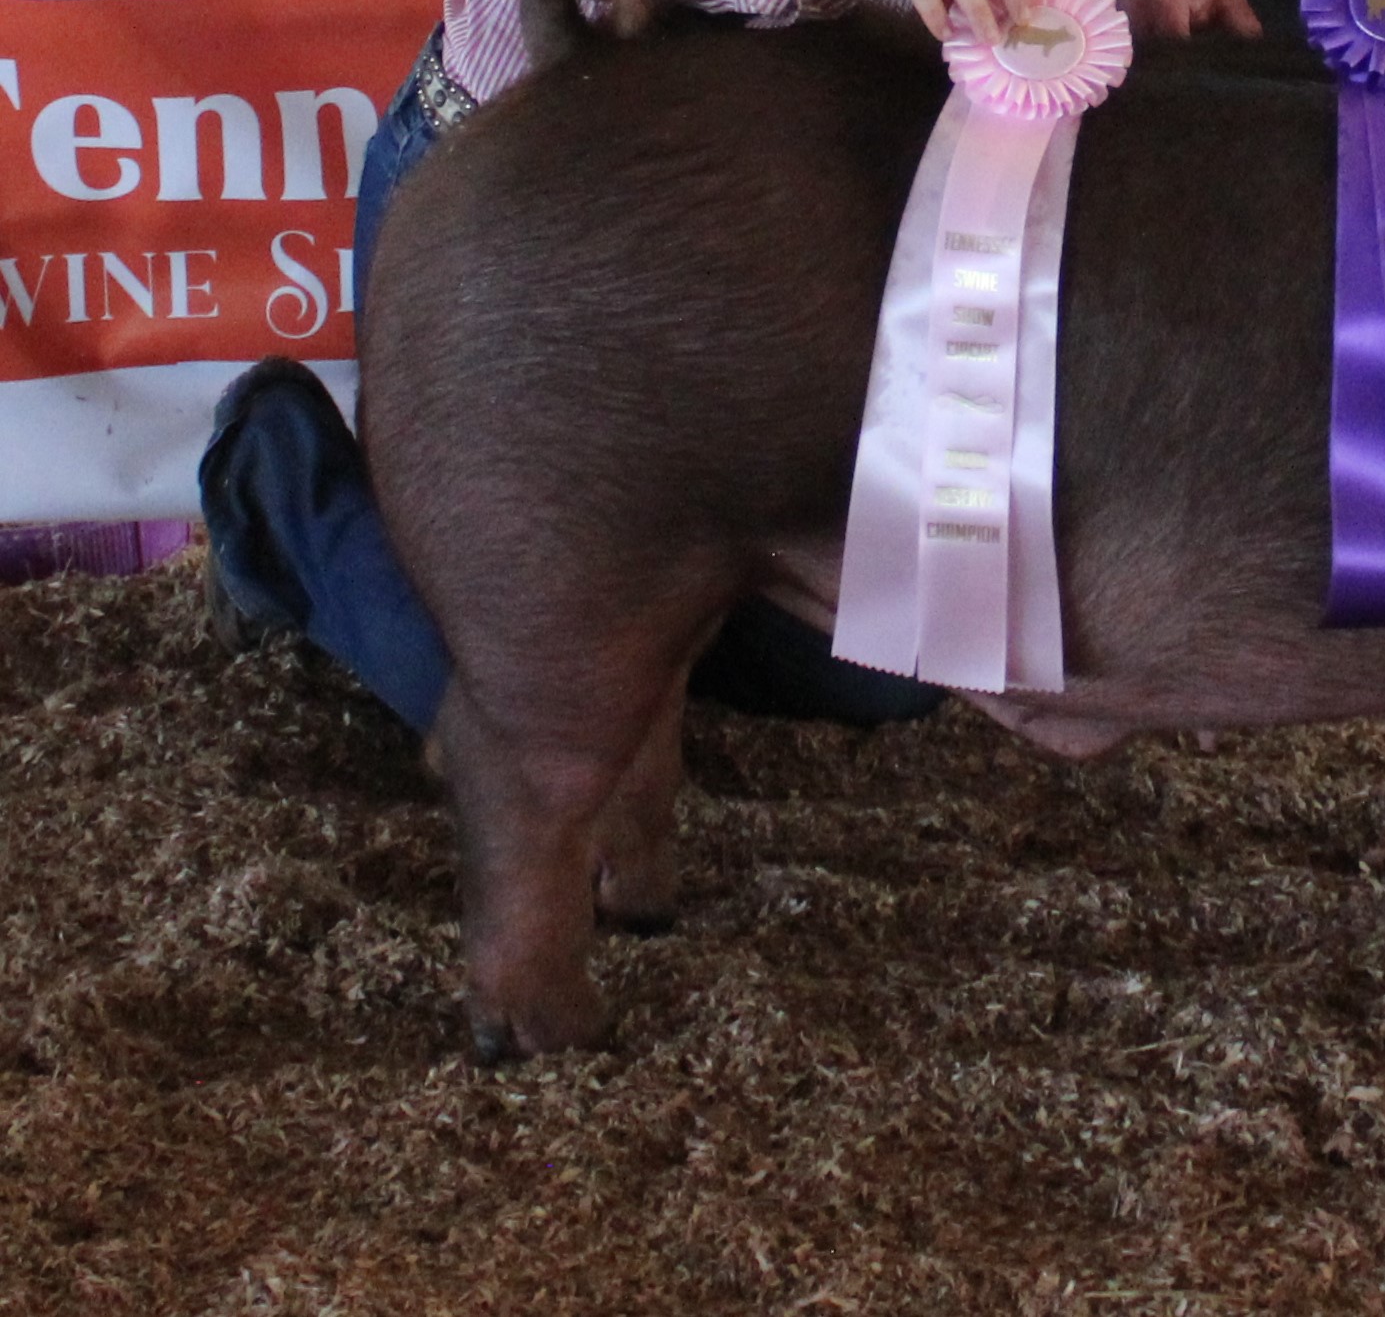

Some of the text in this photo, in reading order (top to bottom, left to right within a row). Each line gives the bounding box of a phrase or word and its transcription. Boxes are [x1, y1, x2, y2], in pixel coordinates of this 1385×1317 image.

[0, 58, 379, 201] enn
[953, 268, 999, 292] SWINE
[926, 522, 1001, 543] CHAMPION
